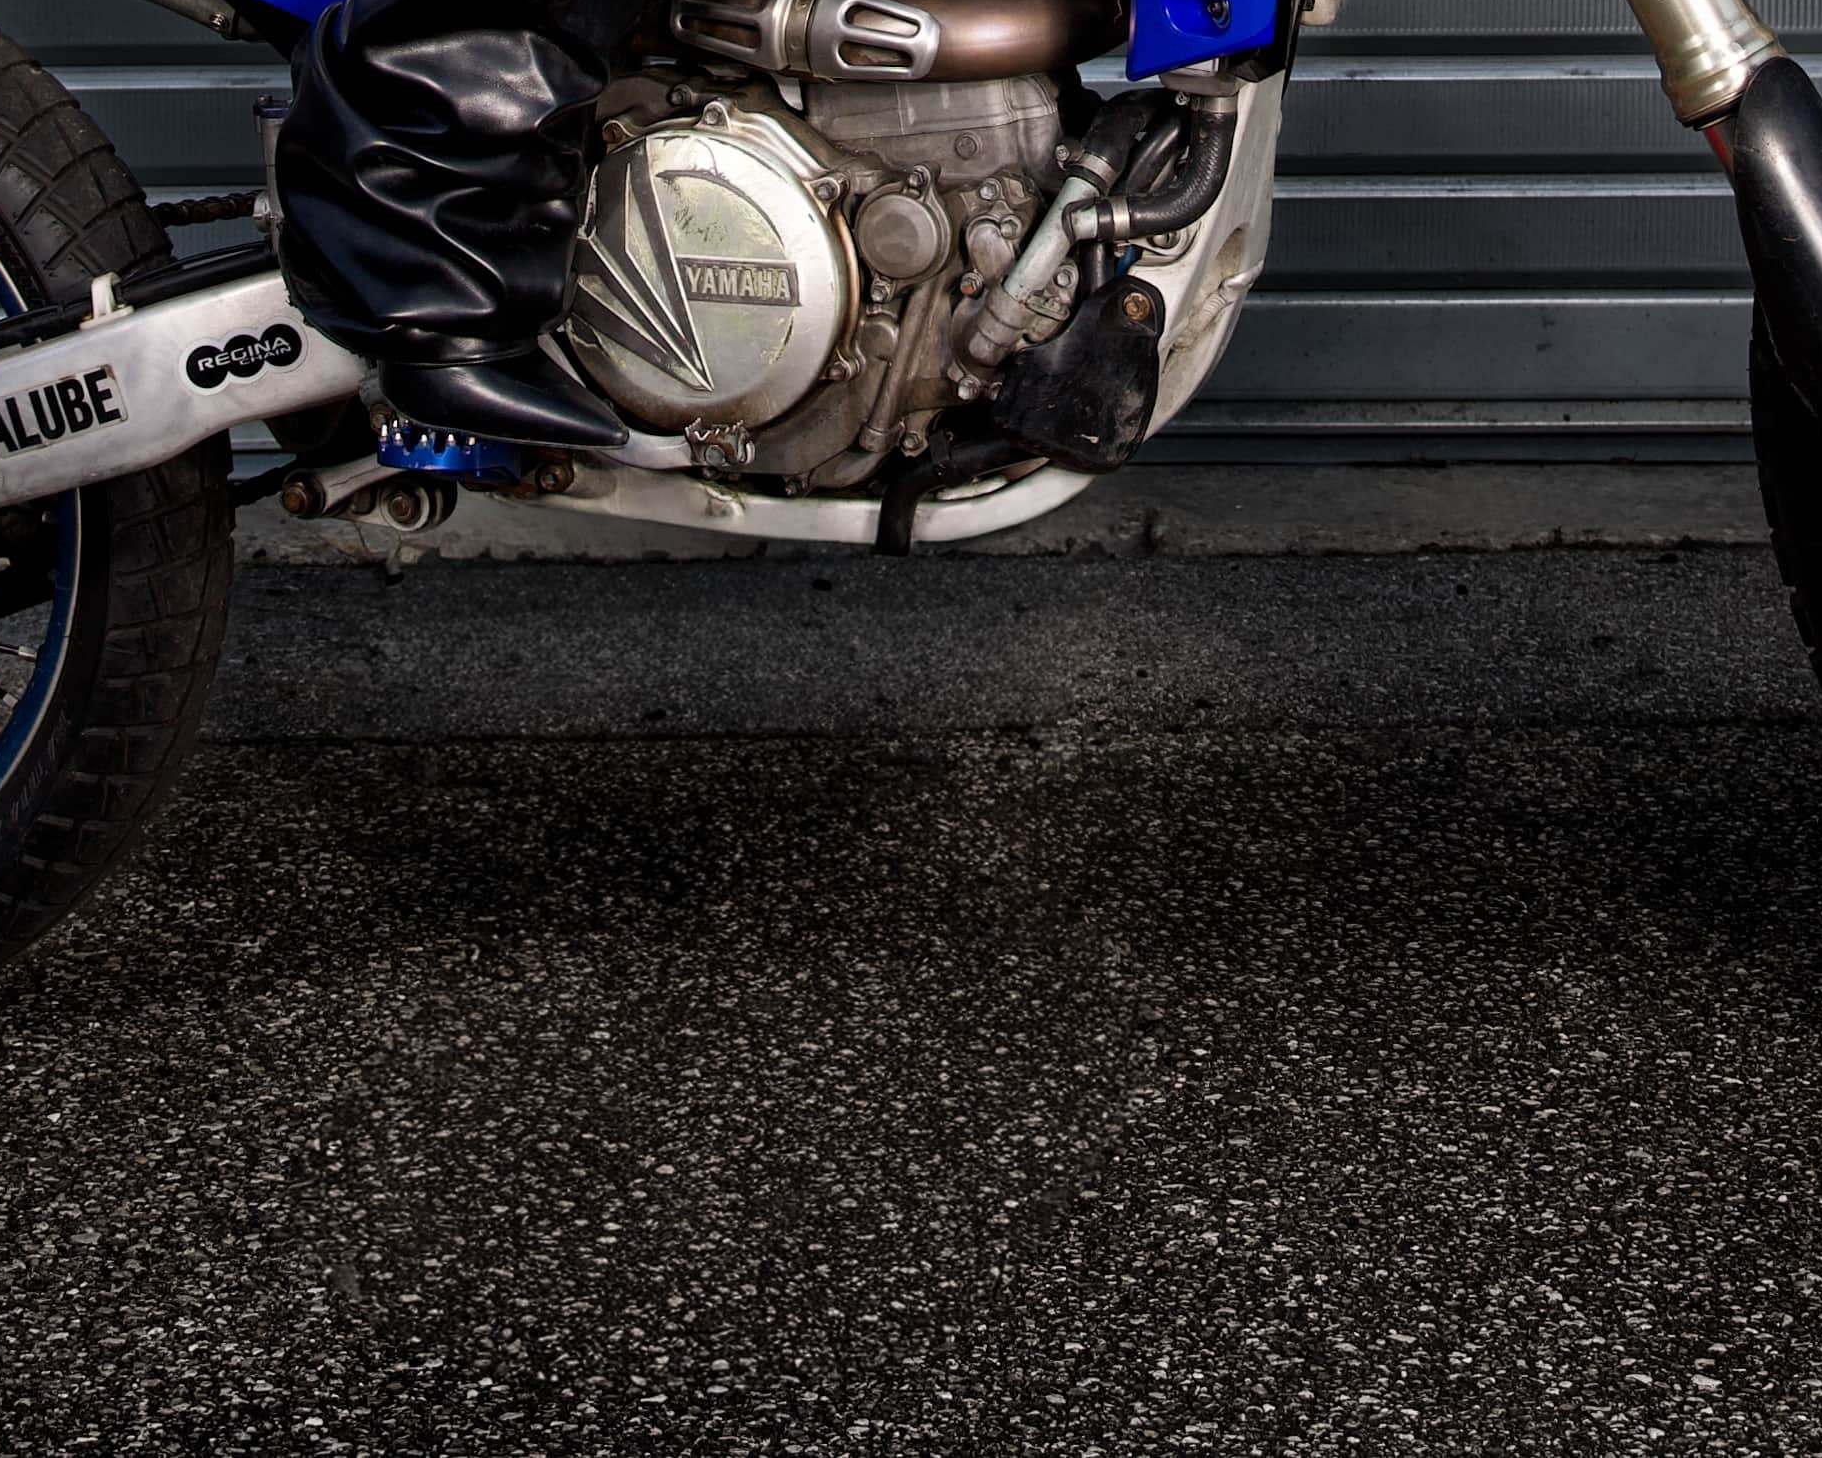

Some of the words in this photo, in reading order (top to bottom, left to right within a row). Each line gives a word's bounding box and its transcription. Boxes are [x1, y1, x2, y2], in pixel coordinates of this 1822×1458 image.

[685, 265, 791, 300] YAMAHA
[197, 337, 289, 372] REGINA
[240, 346, 291, 365] CHAIN
